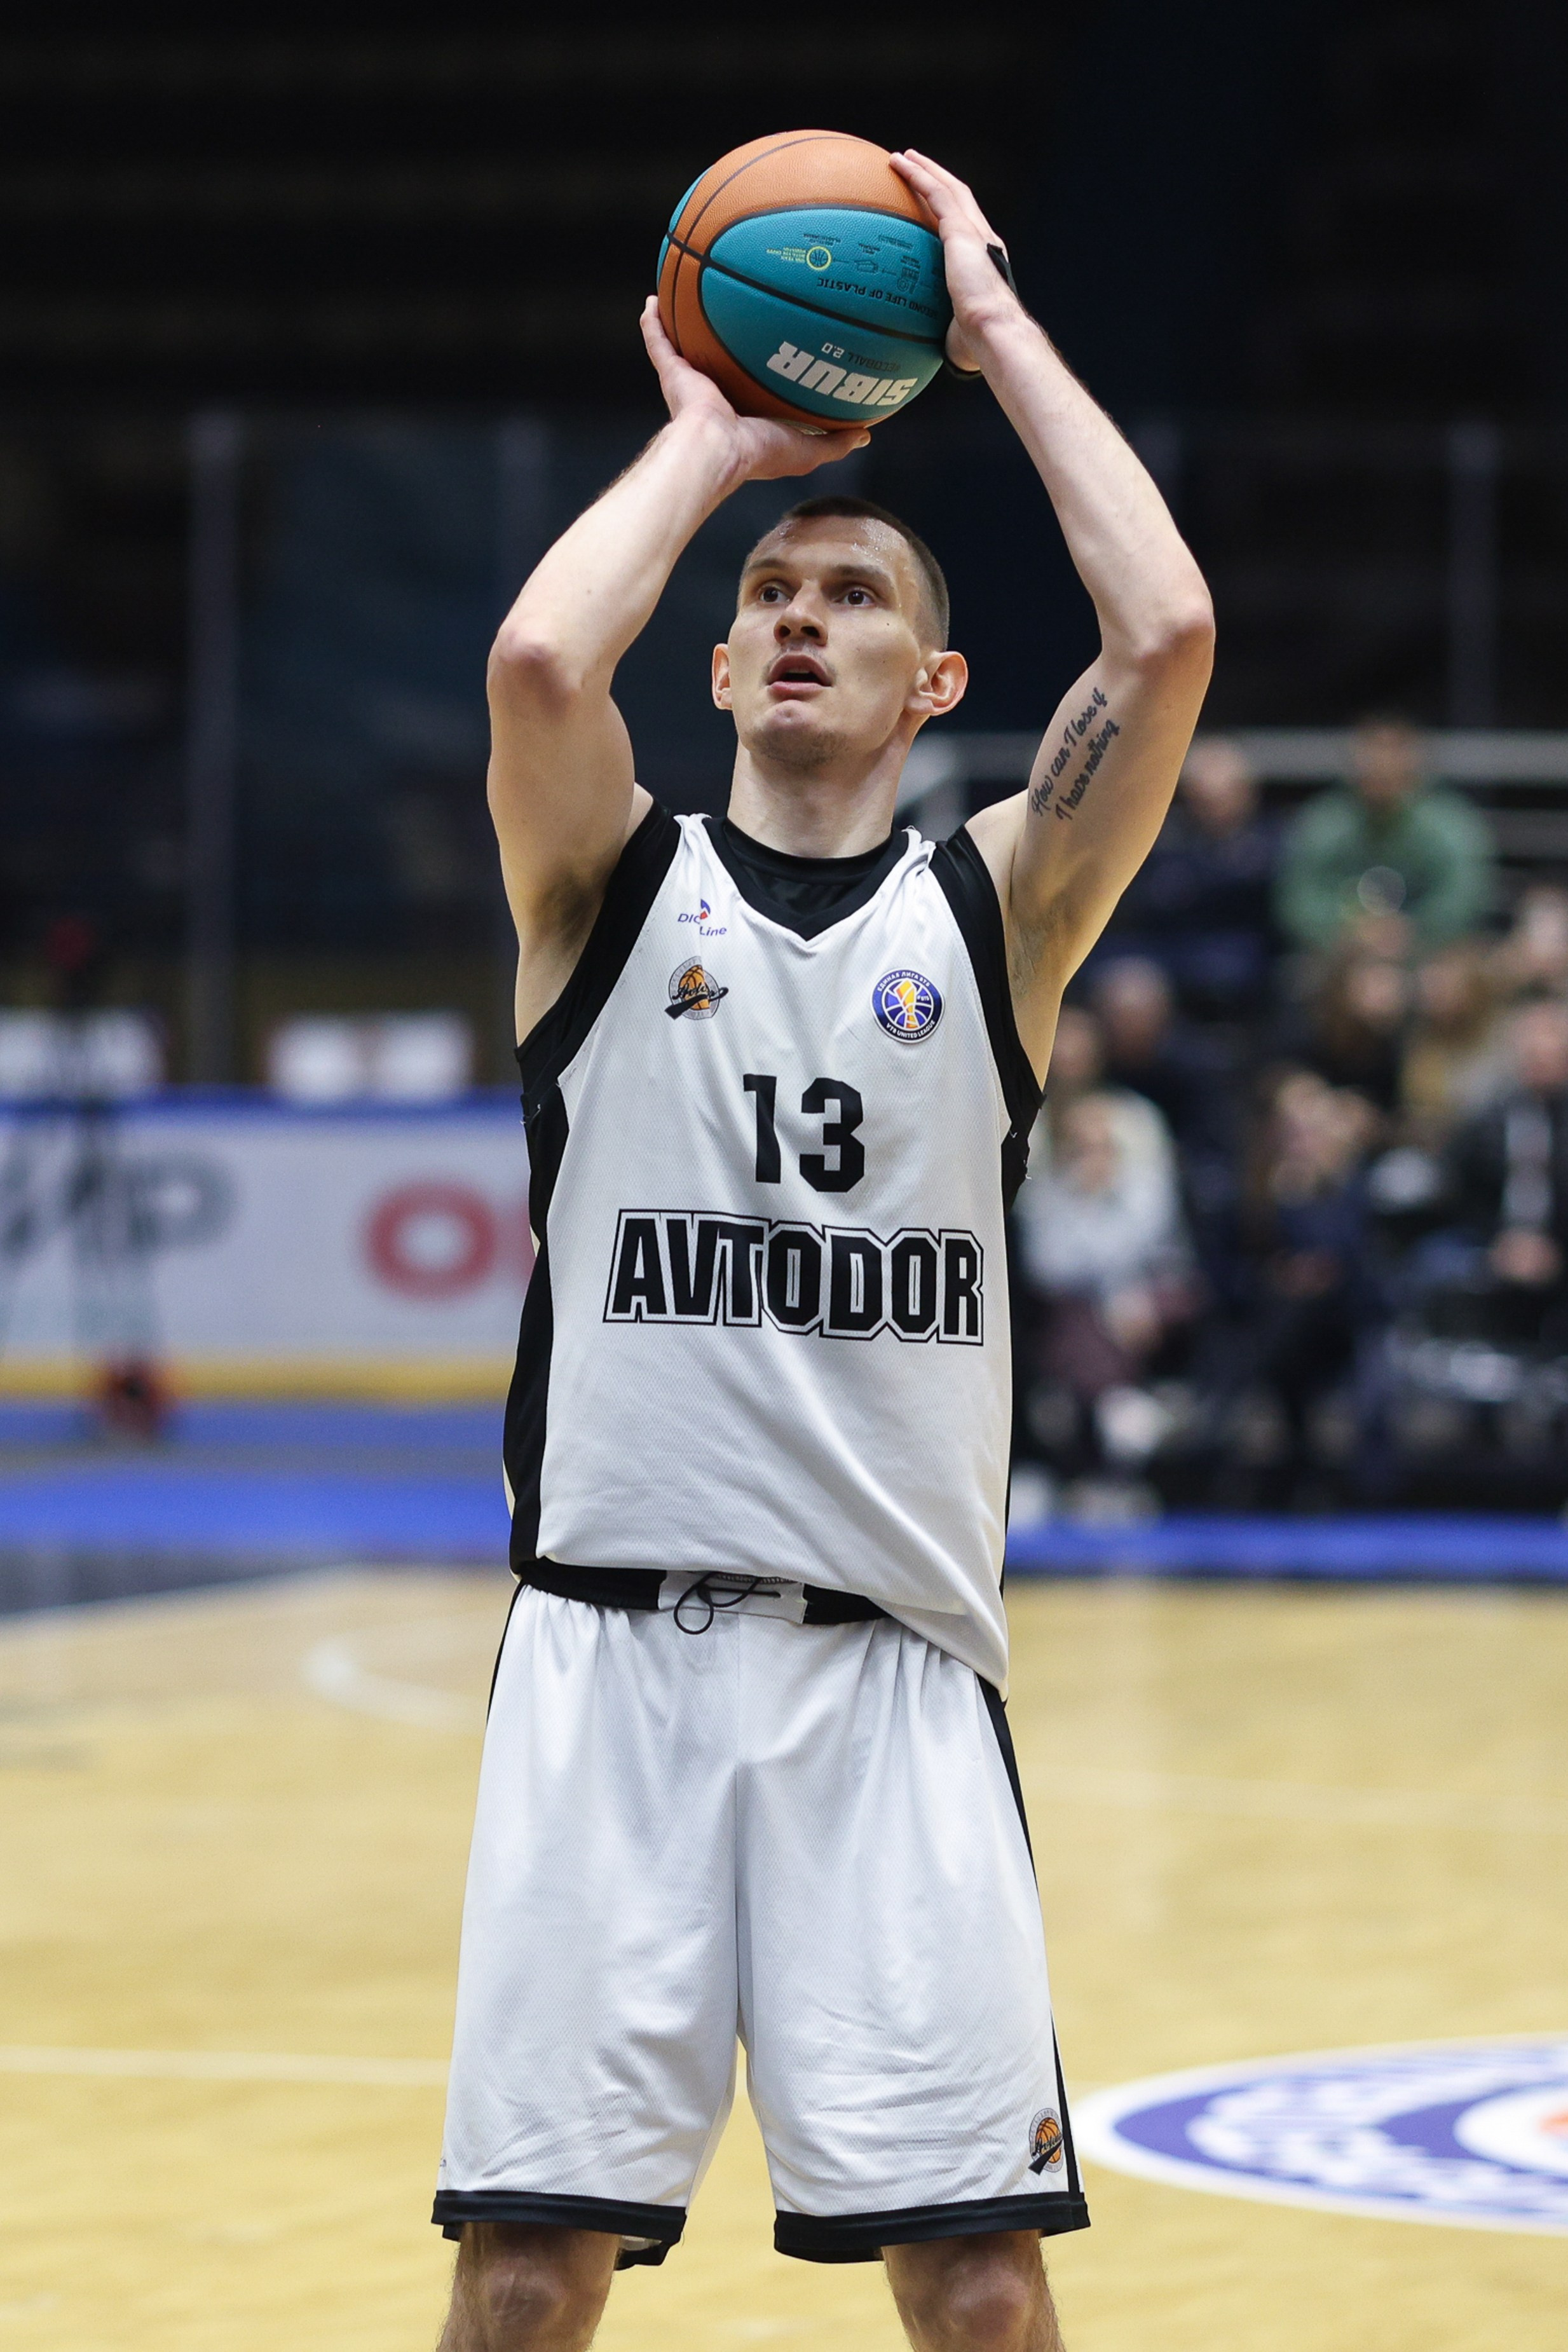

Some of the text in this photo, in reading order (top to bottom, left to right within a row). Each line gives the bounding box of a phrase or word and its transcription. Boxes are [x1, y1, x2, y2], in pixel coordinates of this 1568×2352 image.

[816, 277, 866, 296] PLASTIC
[868, 289, 883, 299] OF
[885, 293, 907, 307] LIFE
[820, 342, 845, 359] 2.0
[766, 341, 918, 406] SIBUR
[1031, 775, 1054, 817] How
[1051, 747, 1071, 777] can
[1063, 727, 1077, 746] I
[1070, 705, 1098, 736] lose
[1055, 803, 1074, 821] I
[1084, 719, 1121, 776] nothing
[699, 926, 728, 936] Line
[901, 971, 919, 980] ЛИГА
[896, 1030, 917, 1039] UNITED
[917, 1019, 936, 1037] LEAGUE
[742, 1073, 865, 1193] 13
[603, 1208, 984, 1346] AVTODOR
